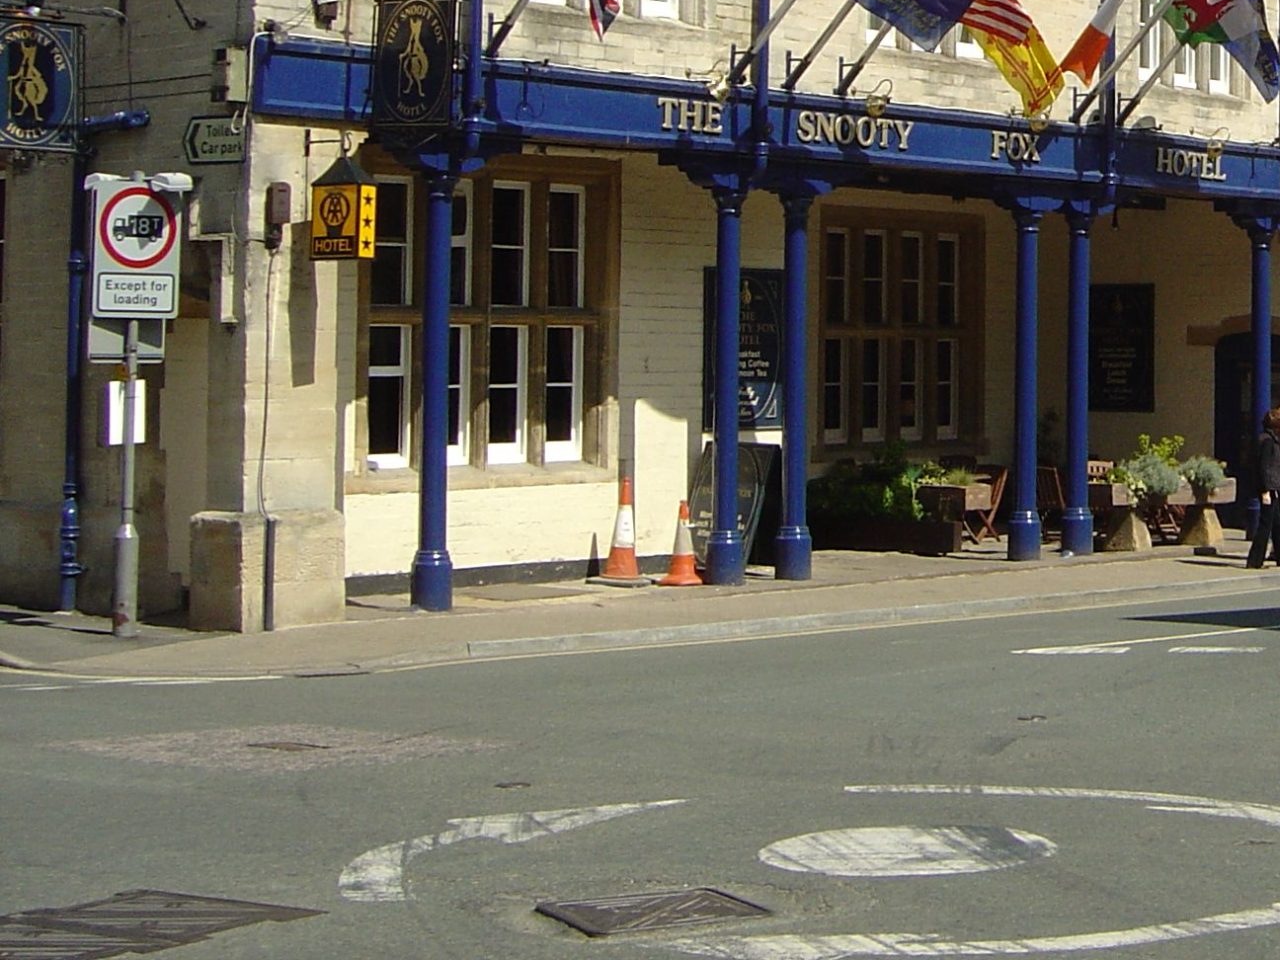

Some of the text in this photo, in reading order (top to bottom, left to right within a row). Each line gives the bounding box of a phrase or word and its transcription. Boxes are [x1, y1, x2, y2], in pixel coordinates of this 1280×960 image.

[387, 5, 443, 44] THE SNOOTY FOX
[5, 29, 66, 72] SNOOTY FOX
[397, 101, 427, 118] HOTEL
[6, 122, 47, 139] HOTEL
[657, 97, 1227, 182] THE SNOOTY FOX HOTEL
[200, 141, 242, 156] Car park
[314, 238, 353, 253] HOTEL
[104, 278, 168, 293] Except for
[113, 294, 158, 307] loading
